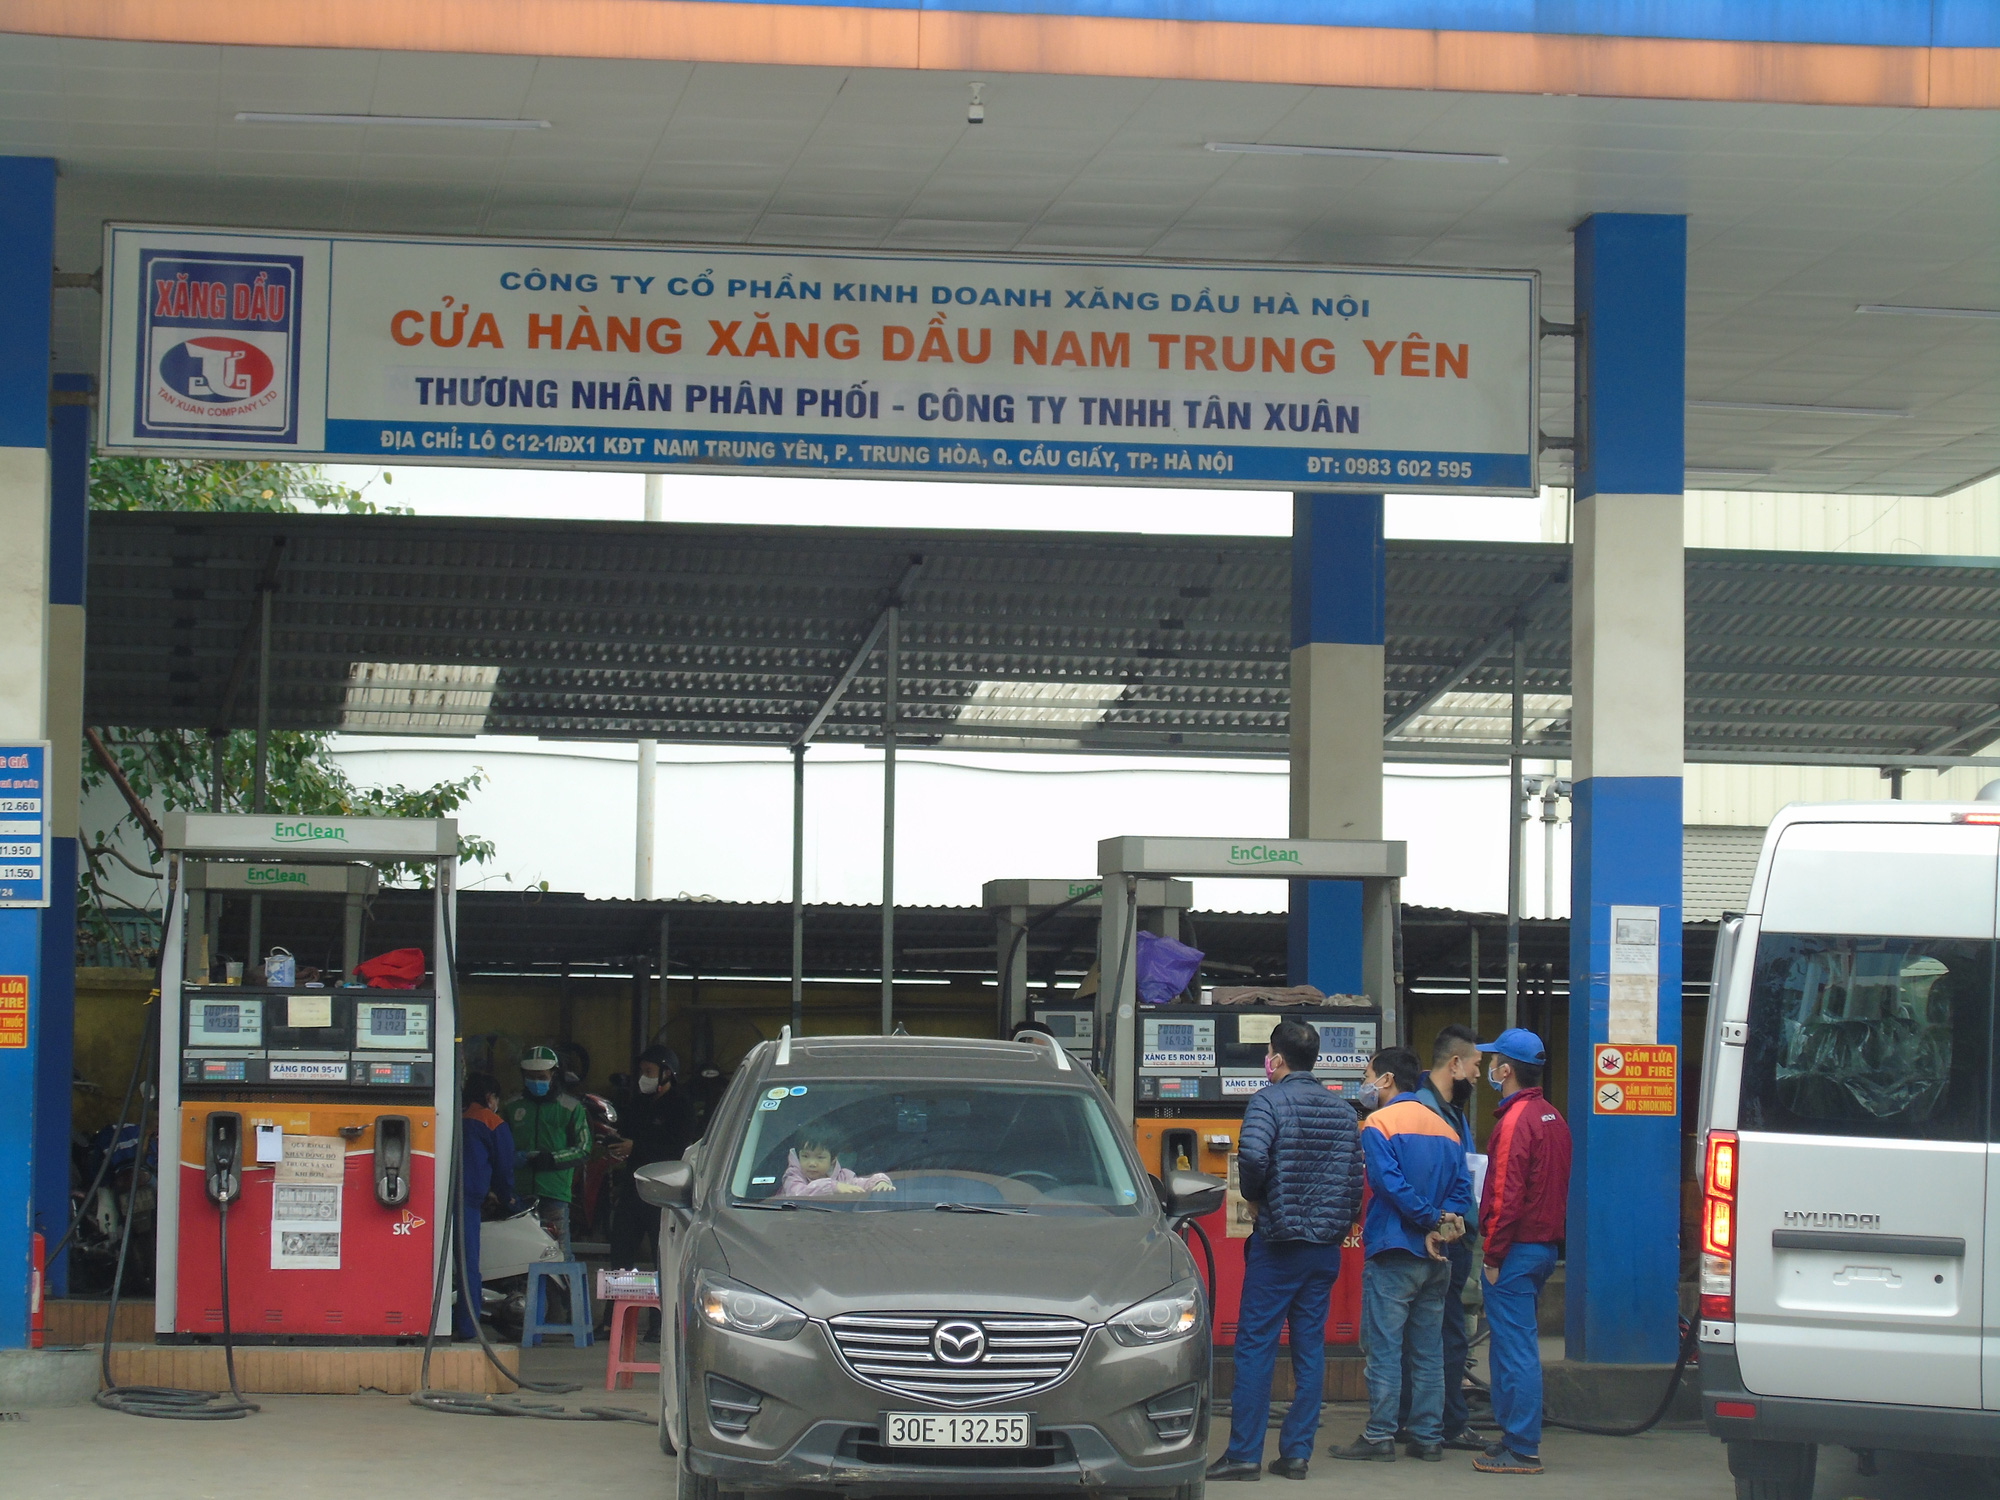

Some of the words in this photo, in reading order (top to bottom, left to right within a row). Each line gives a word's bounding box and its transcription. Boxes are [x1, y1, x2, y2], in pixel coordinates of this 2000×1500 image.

[154, 272, 226, 320] XĂNG
[233, 272, 285, 322] DẦU
[500, 268, 598, 292] CÔNG
[610, 276, 656, 294] TY
[667, 268, 714, 296] CỔ
[728, 273, 821, 300] PHẦN
[834, 282, 918, 304] KINH
[932, 286, 1052, 308] DOANH
[1064, 287, 1160, 310] XĂNG
[1171, 287, 1240, 314] DẦU
[1253, 292, 1300, 315] HÀ
[1312, 294, 1370, 321] NỘI
[390, 296, 504, 349] CỬA
[528, 305, 682, 354] HÀNG
[706, 312, 860, 360] XĂNG
[882, 312, 992, 364] DẦU
[1014, 329, 1130, 368] NAM
[1148, 334, 1336, 374] TRUNG
[1362, 332, 1468, 379] YÊN
[158, 387, 174, 404] TAN
[176, 399, 204, 416] XUAN
[208, 402, 258, 416] COMPANY
[259, 390, 278, 406] LTD
[415, 376, 558, 408] THƯƠNG
[572, 376, 672, 412] NHÂN
[685, 380, 783, 416] PHÂN
[796, 380, 879, 419] PHỐI
[918, 388, 1014, 423] CÔNG
[1027, 396, 1067, 424] TY
[1079, 397, 1171, 428] TNHH
[1184, 395, 1251, 430] TÂN
[1264, 399, 1360, 434] XUÂN
[380, 430, 416, 450] ĐỊA
[422, 426, 462, 449] CHỈ:
[470, 430, 496, 450] LÔ
[604, 437, 645, 456] KĐT
[654, 439, 698, 456] NAM
[705, 440, 775, 458] TRUNG
[782, 440, 829, 464] YÊN,
[835, 444, 853, 462] P.
[860, 445, 930, 464] TRUNG
[938, 444, 988, 468] HÒA,
[992, 448, 1012, 466] Q.
[1019, 444, 1060, 467] CẦU
[1066, 445, 1120, 472] GIẤY,
[1128, 452, 1158, 470] TP:
[1164, 450, 1196, 470] HÀ
[1198, 451, 1233, 474] NỘI
[1307, 456, 1340, 474] ĐT:
[1345, 458, 1392, 476] 0983
[1397, 460, 1432, 477] 602
[1438, 462, 1472, 478] 595
[8, 754, 28, 768] GIÁ
[276, 822, 344, 838] EnClean
[1231, 846, 1298, 861] EnClean
[4, 868, 34, 879] 11.550
[248, 868, 306, 882] EnClean
[1625, 1048, 1650, 1062] CẤM
[274, 1064, 298, 1072] XĂNG
[1626, 1066, 1642, 1076] NO
[1648, 1066, 1673, 1076] FIRE
[1626, 1100, 1636, 1110] NO
[1638, 1100, 1672, 1112] SMOKING
[1784, 1210, 1880, 1230] HYUNDAI
[392, 1222, 411, 1235] SK
[1342, 1236, 1360, 1248] SK
[892, 1418, 1024, 1443] 30E-132.55
